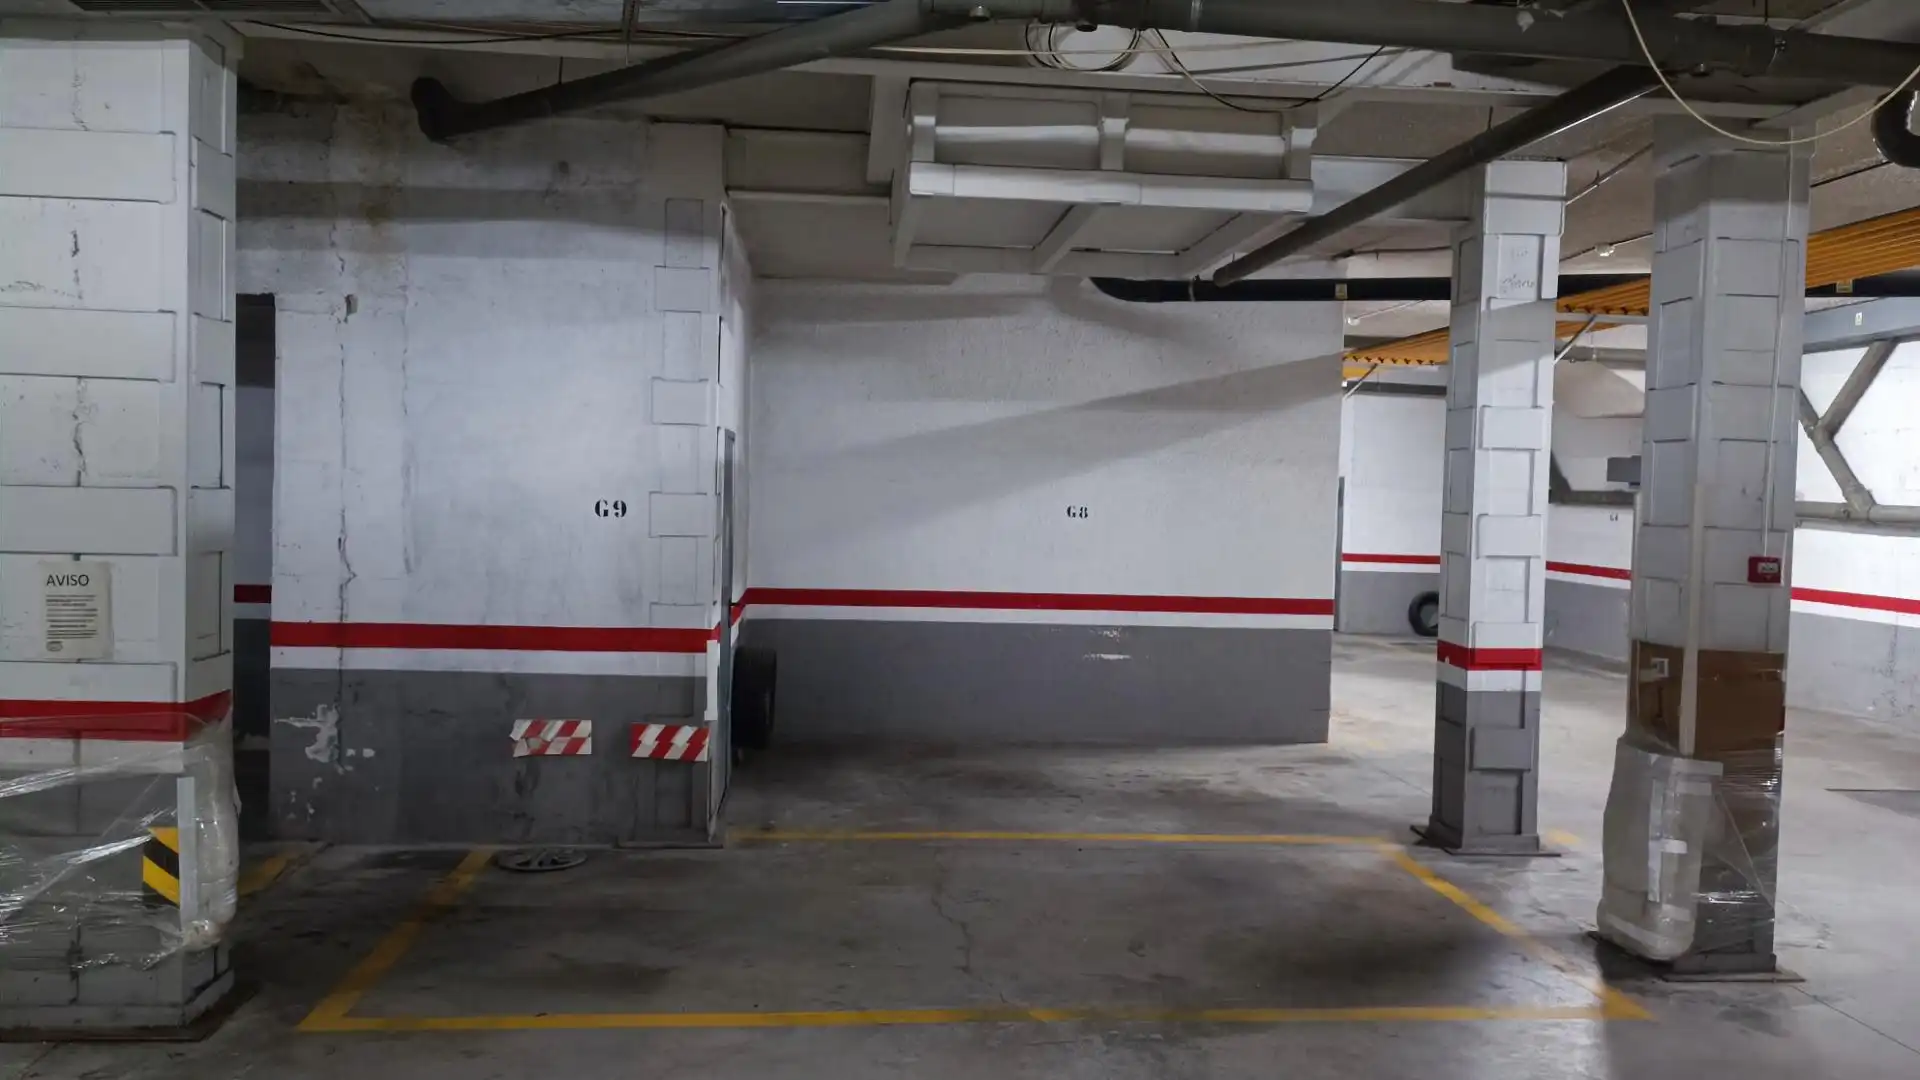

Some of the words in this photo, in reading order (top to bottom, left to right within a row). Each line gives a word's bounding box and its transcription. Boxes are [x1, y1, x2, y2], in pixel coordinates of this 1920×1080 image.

[594, 499, 627, 517] G9
[1066, 505, 1088, 518] G8
[46, 574, 89, 586] AVISO
